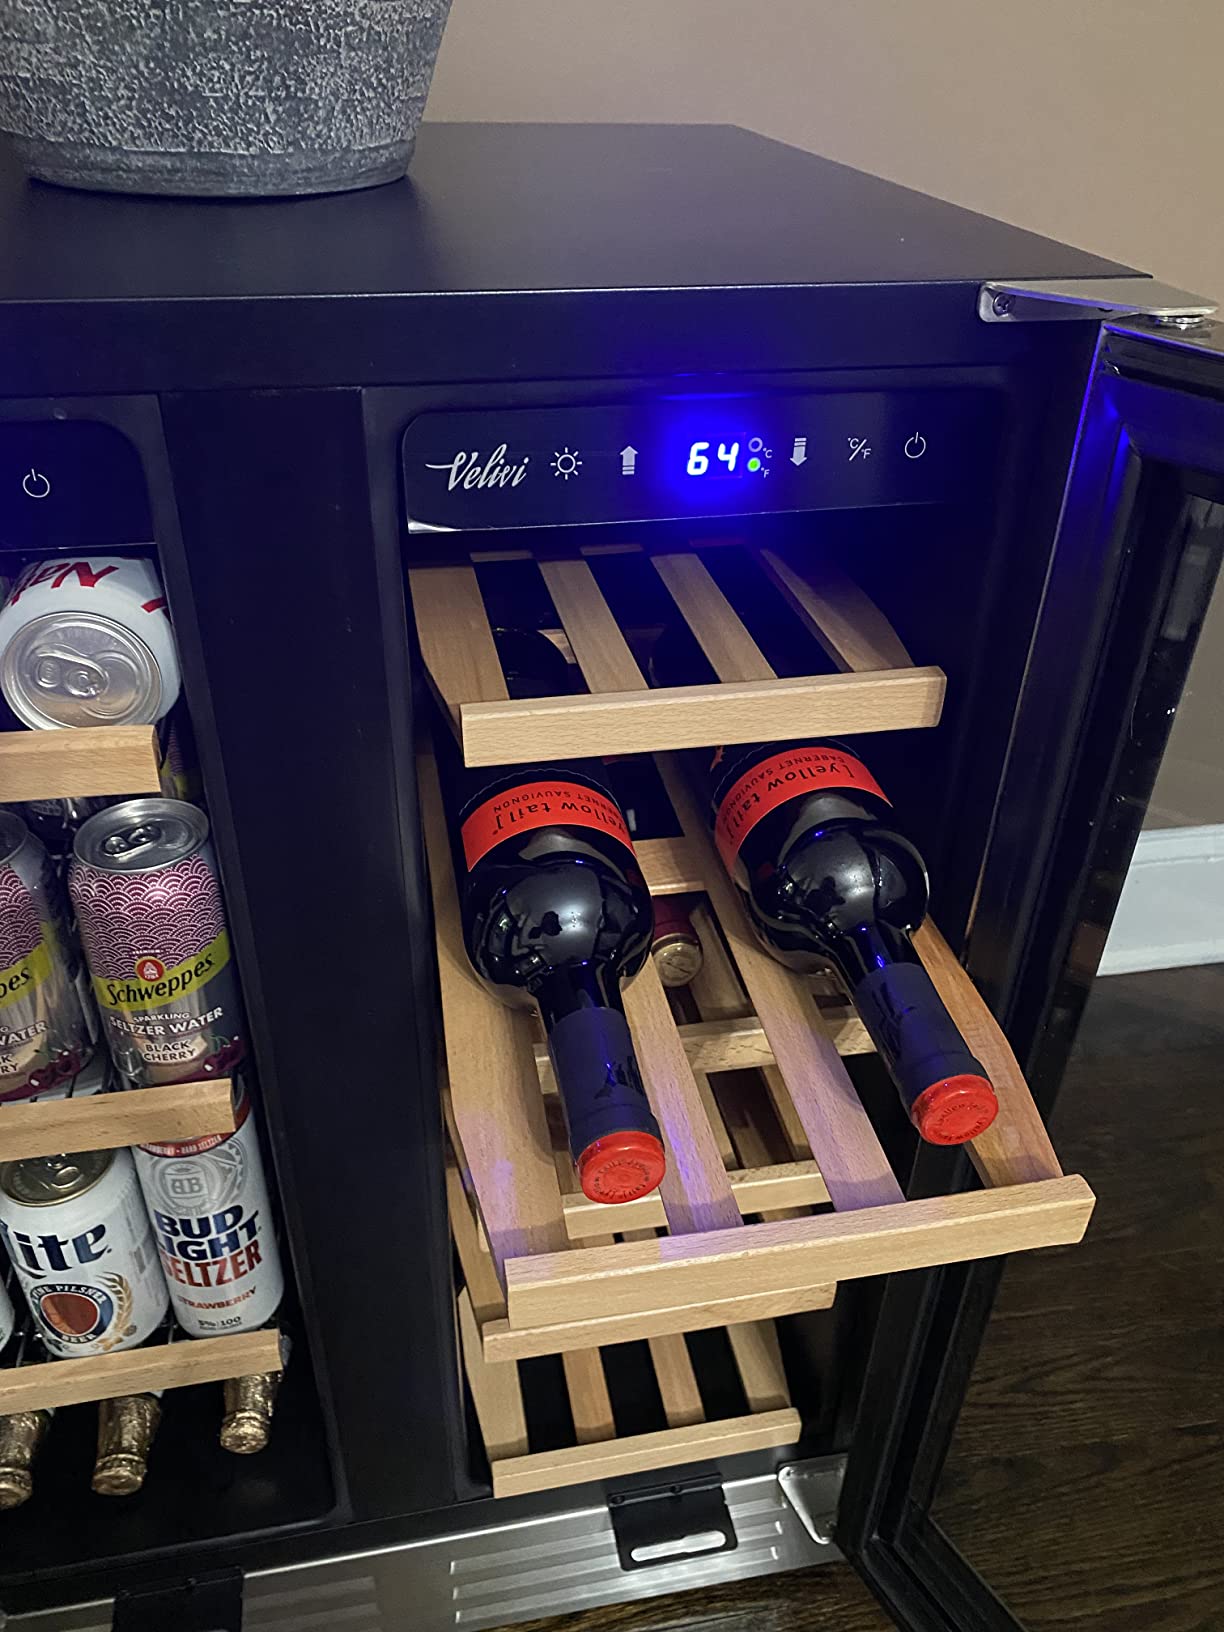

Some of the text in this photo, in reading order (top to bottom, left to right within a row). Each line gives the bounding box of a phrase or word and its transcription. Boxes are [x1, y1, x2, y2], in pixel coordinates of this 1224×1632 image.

[425, 443, 529, 491] Velivi
[686, 441, 740, 475] 64
[493, 790, 571, 813] SAUVIGNON
[107, 953, 215, 1006] Schweppes
[109, 1006, 224, 1035] SELTZER WATER
[133, 1012, 191, 1022] SPARKLING
[143, 1048, 196, 1061] CHERRY
[145, 1040, 191, 1052] BLACK
[154, 1204, 243, 1239] BUD
